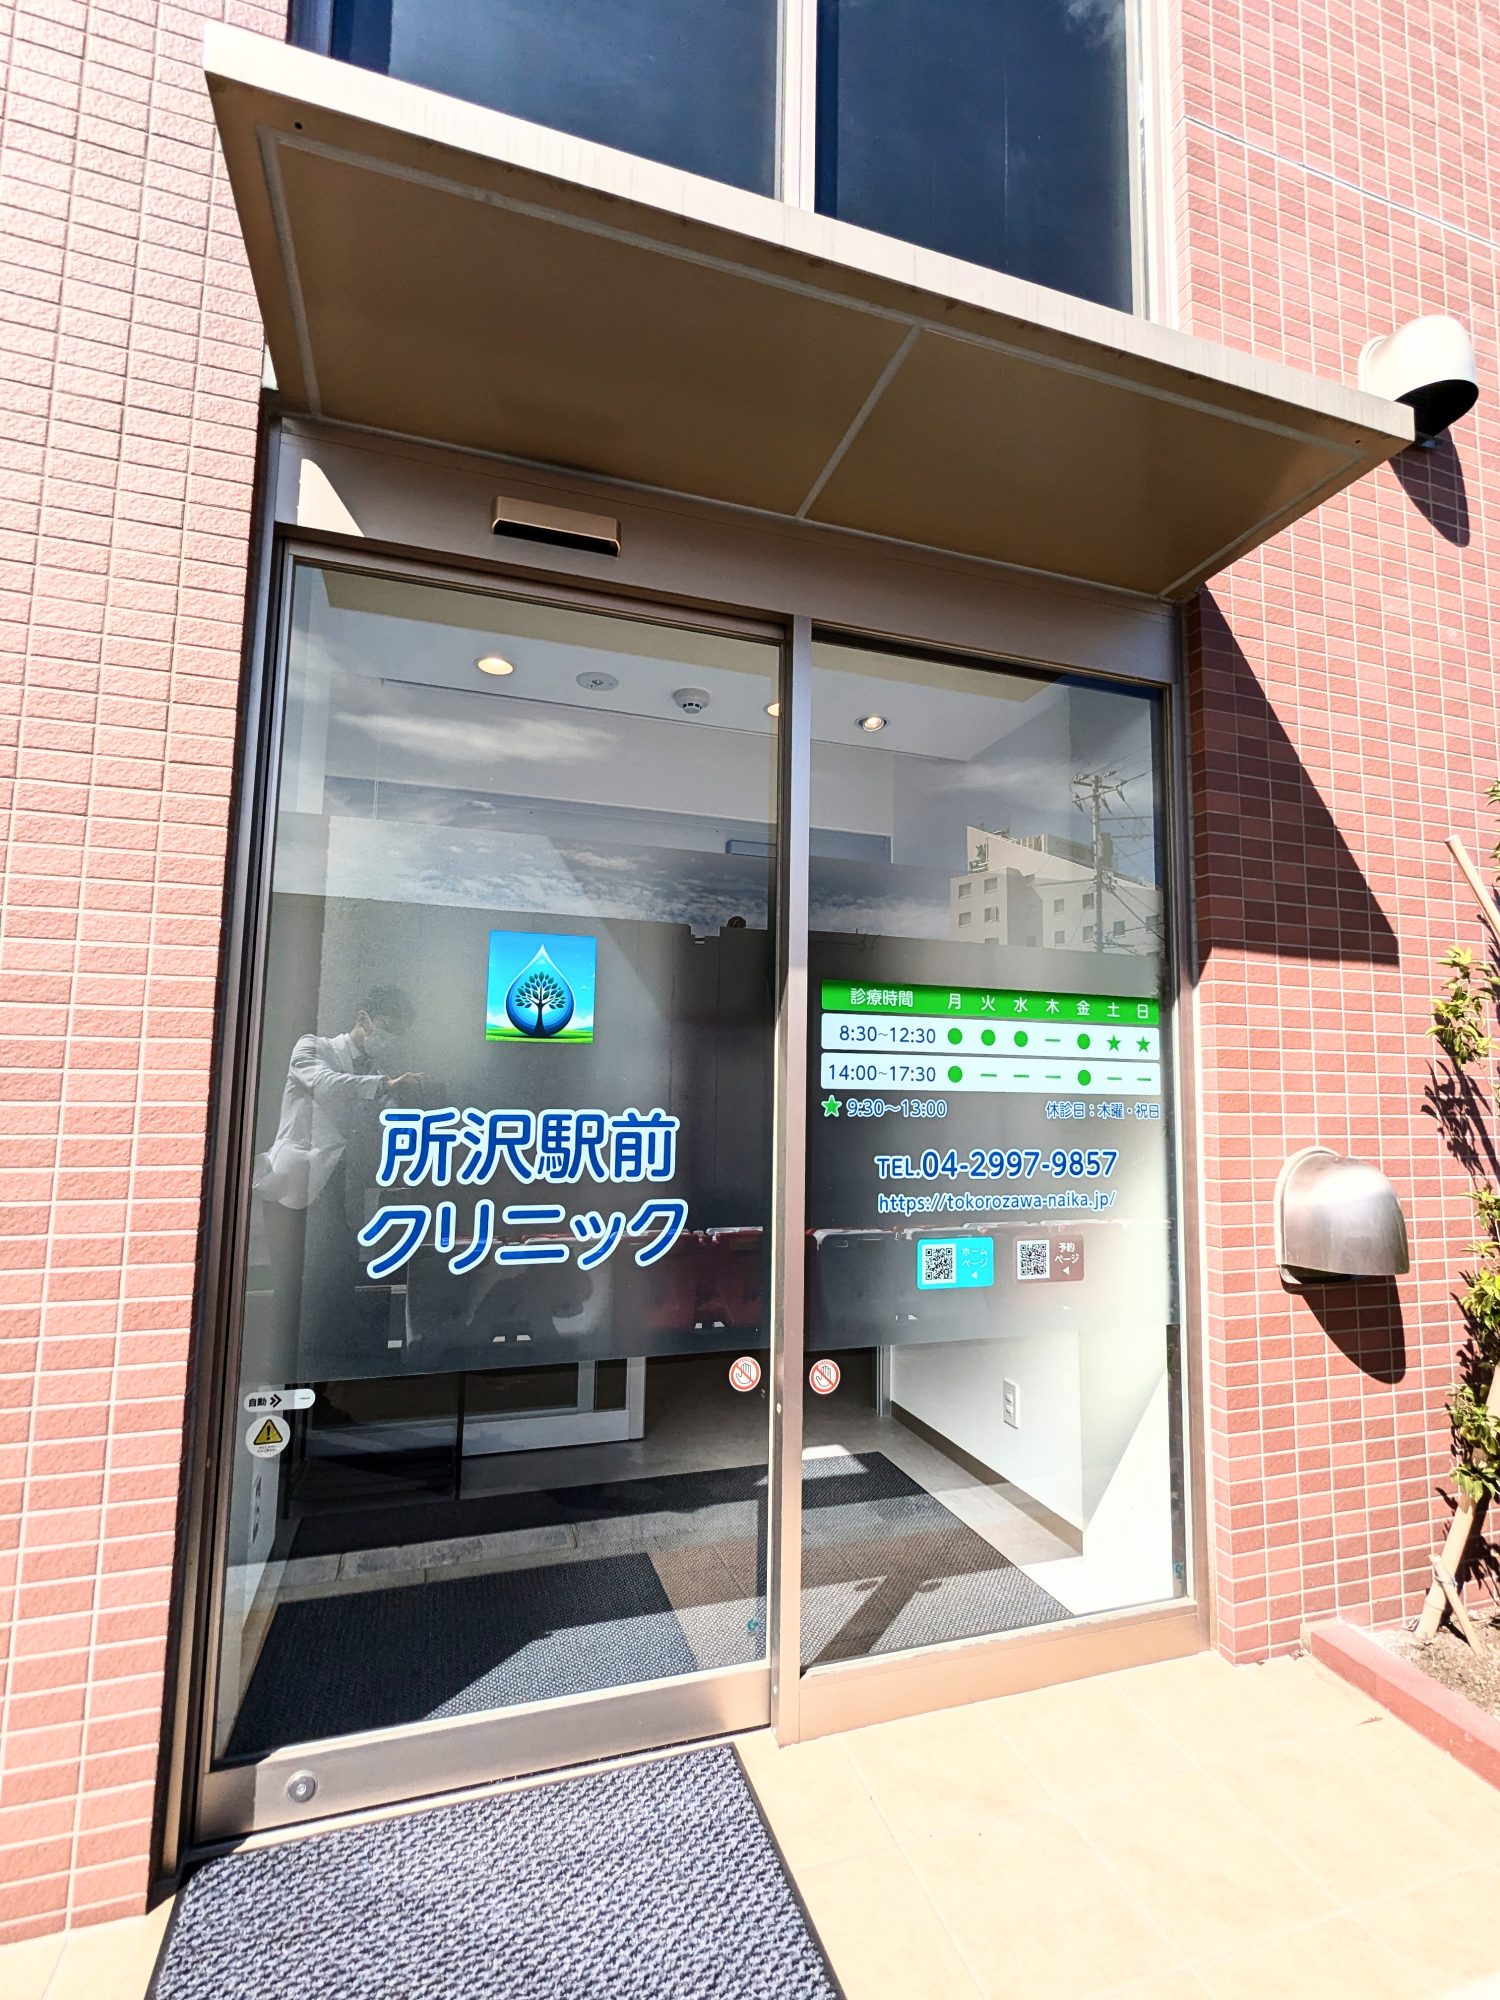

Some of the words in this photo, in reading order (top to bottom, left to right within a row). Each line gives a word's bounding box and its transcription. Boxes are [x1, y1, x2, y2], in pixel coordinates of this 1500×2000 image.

[850, 987, 914, 1008] 診療時間
[948, 993, 961, 1010] 月
[980, 995, 996, 1011] 火
[1013, 997, 1028, 1013] 水
[1045, 998, 1060, 1015] 木
[1076, 1000, 1091, 1016] 金
[1107, 1002, 1121, 1018] 土
[1137, 1003, 1149, 1019] 日
[376, 1107, 679, 1186] 所沢駅前
[877, 1190, 1117, 1216] https://tokorozawa-naika.jp/
[357, 1199, 688, 1279] クリニック
[962, 1247, 988, 1257] ホーム
[1058, 1242, 1075, 1253] 予約
[962, 1258, 988, 1269] ページ
[1054, 1253, 1080, 1265] ページ
[249, 1397, 267, 1408] 自動
